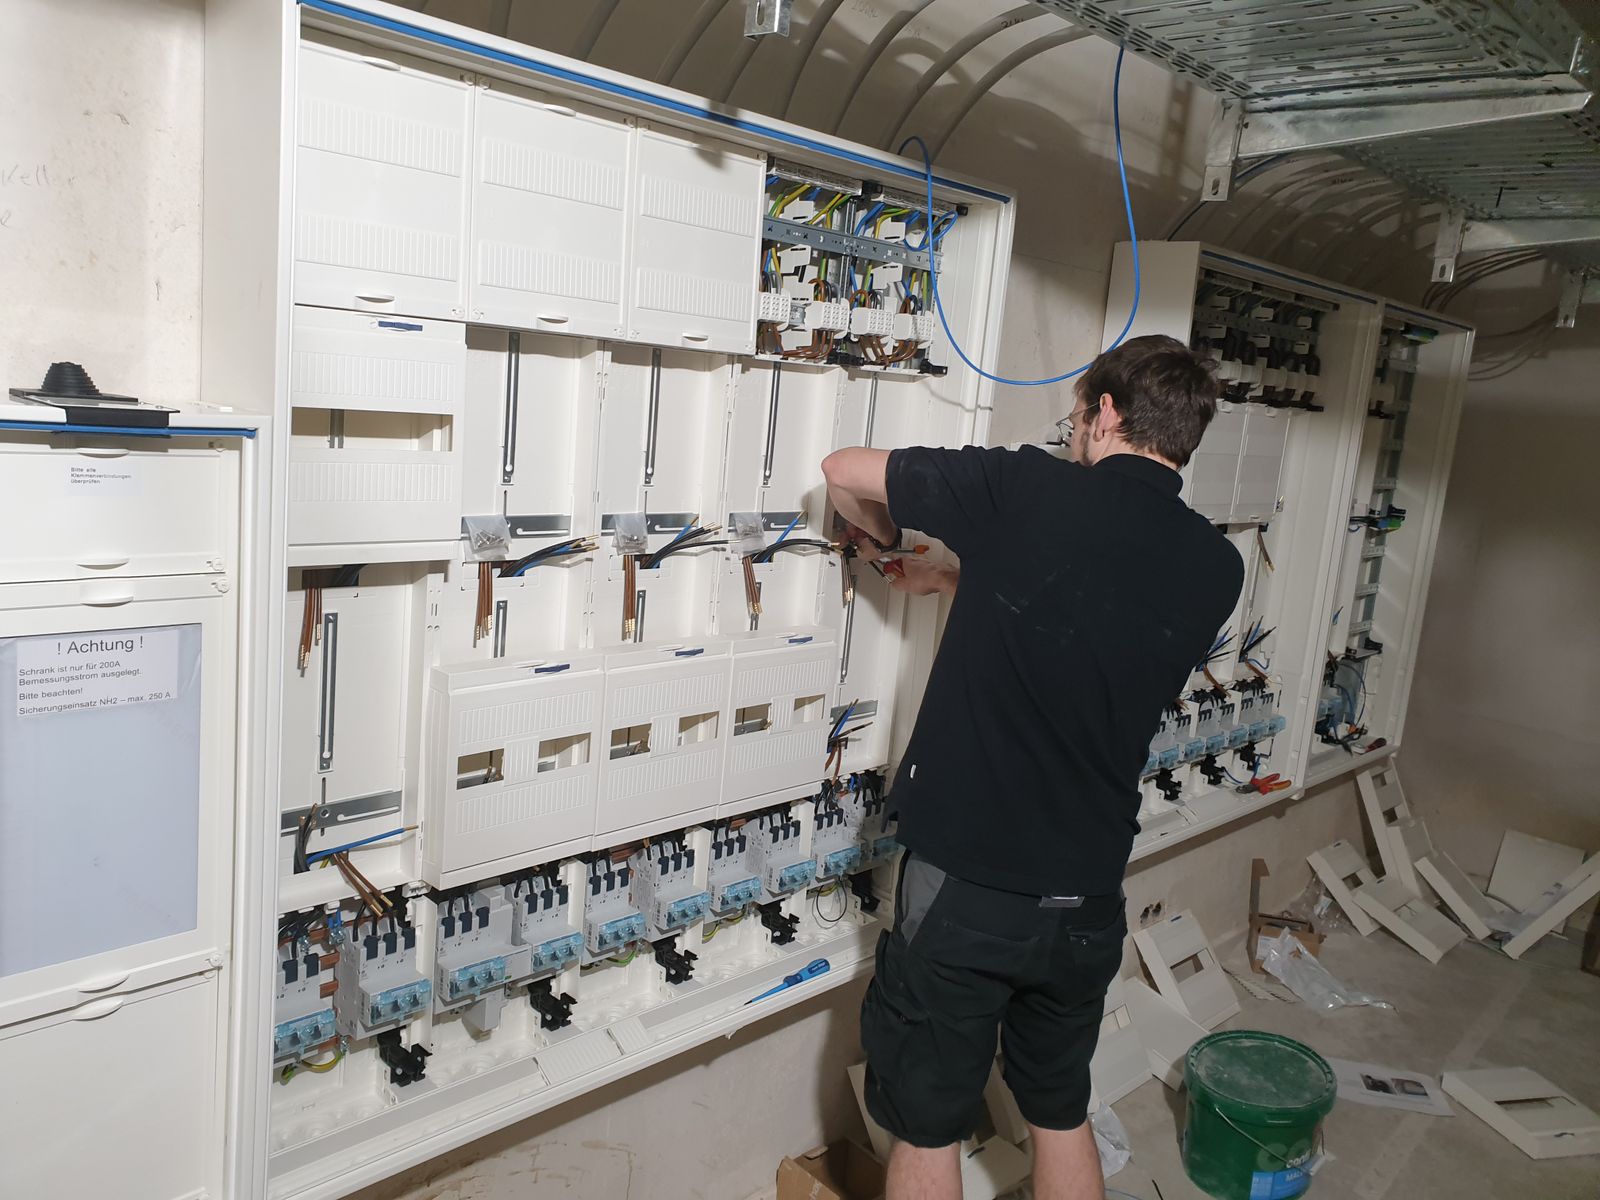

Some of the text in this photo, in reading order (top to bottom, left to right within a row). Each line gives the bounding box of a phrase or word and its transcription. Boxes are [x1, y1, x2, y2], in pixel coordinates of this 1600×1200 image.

[57, 635, 144, 655] ! Achtung !
[19, 660, 121, 677] Schrank ist nur für 200A
[19, 668, 143, 687] Bemessungsstrom ausgelegt.
[19, 687, 83, 701] Bitte beachten!
[19, 700, 98, 715] Sicherungseinsatz
[99, 697, 118, 706] NH2
[148, 692, 163, 701] 250
[164, 691, 171, 699] A
